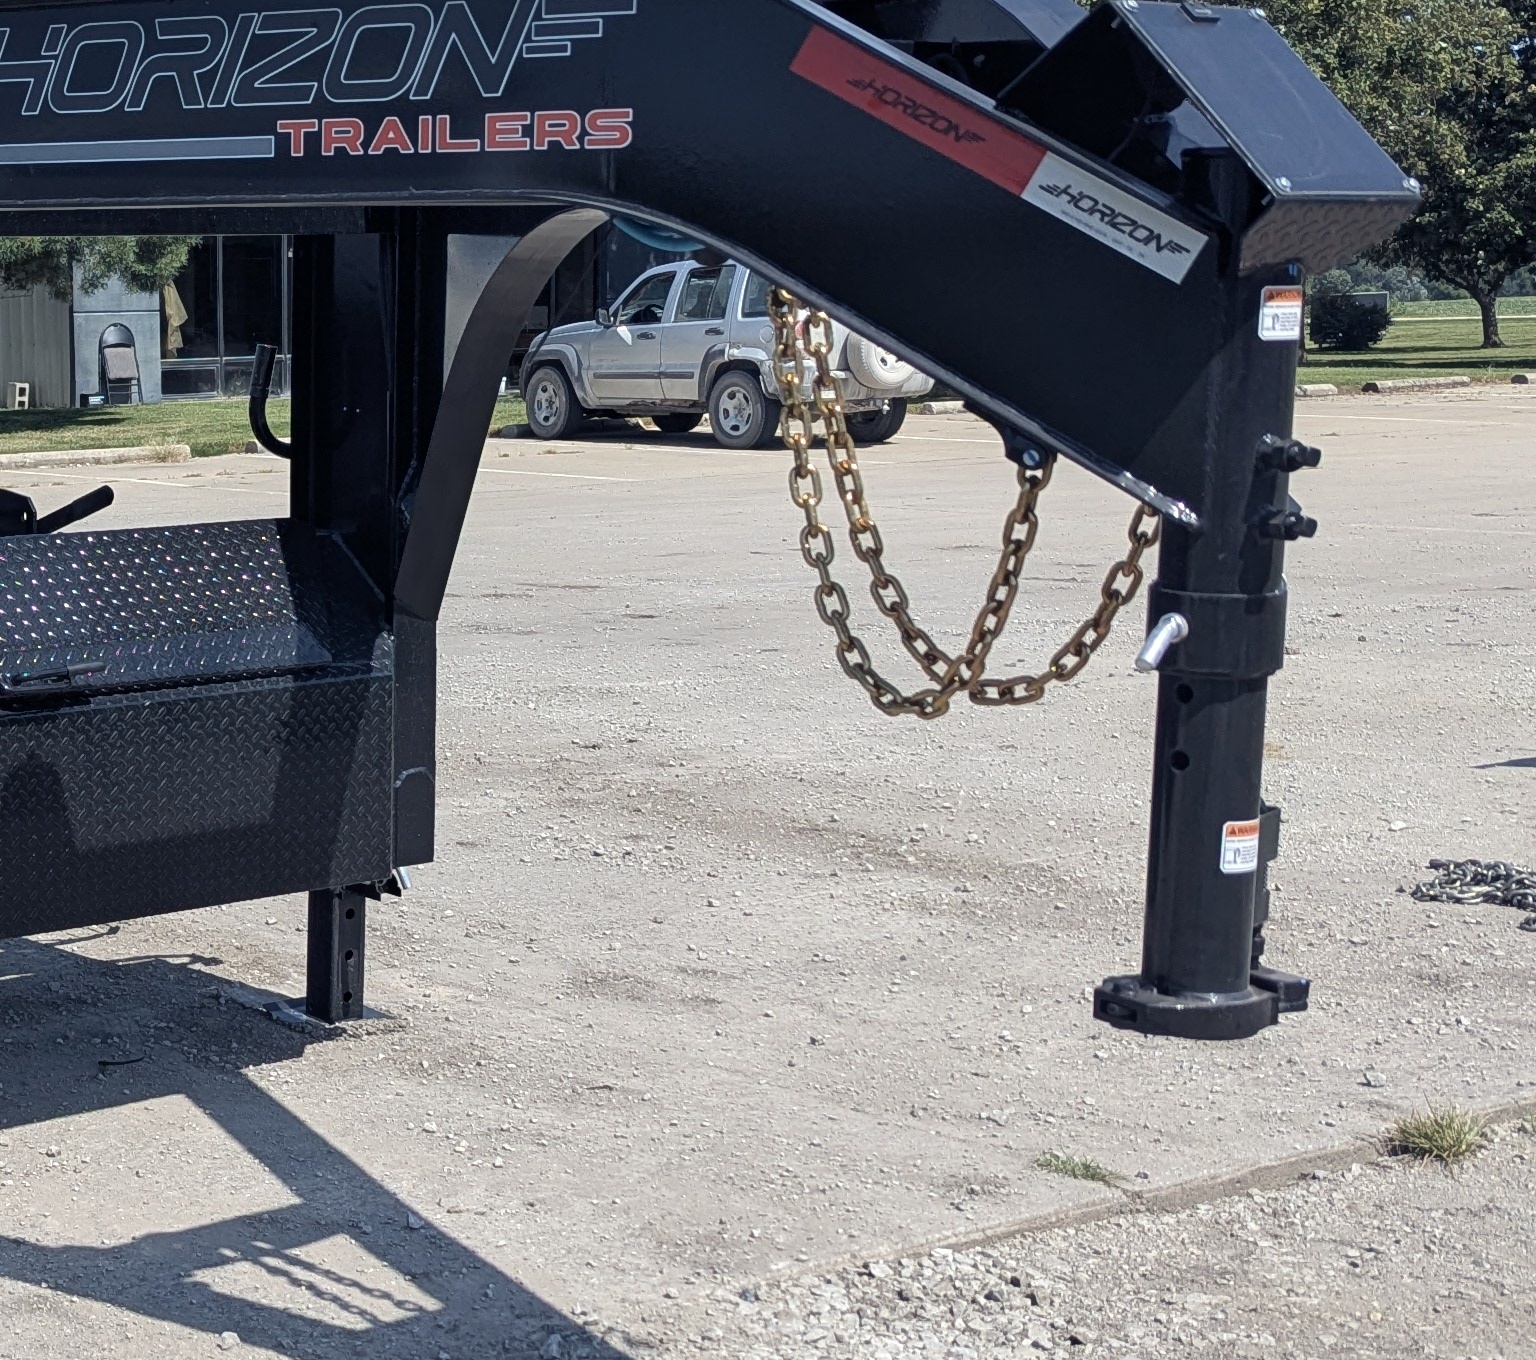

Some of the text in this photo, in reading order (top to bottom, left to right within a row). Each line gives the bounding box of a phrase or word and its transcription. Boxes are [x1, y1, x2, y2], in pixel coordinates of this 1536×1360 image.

[276, 108, 633, 157] TRAILERS
[858, 79, 975, 145] HORIZON
[1052, 182, 1176, 256] HORIZON
